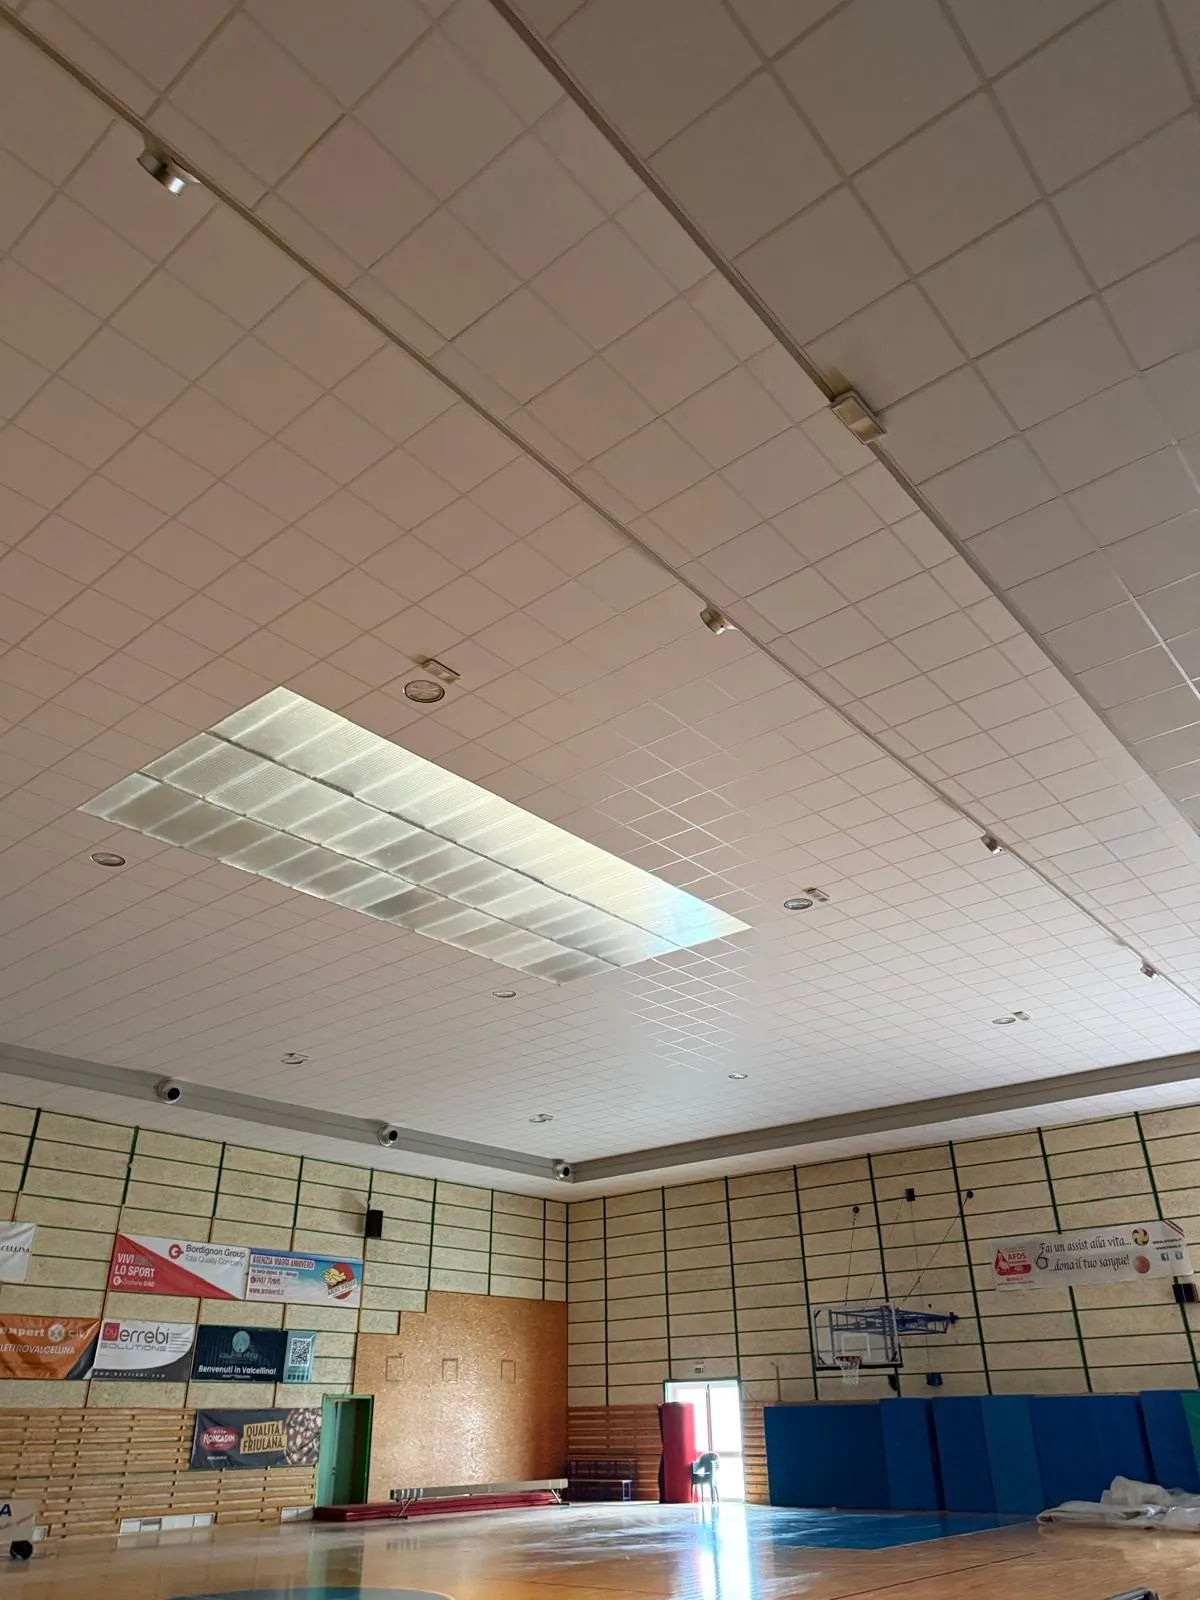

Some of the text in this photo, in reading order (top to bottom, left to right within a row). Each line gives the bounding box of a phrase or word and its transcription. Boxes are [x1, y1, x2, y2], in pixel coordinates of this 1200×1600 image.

[1054, 1243, 1065, 1252] un
[1067, 1239, 1088, 1251] assist
[1090, 1235, 1106, 1249] alla
[185, 1244, 246, 1259] Bordignon Group
[1007, 1252, 1027, 1261] AFDS
[117, 1253, 135, 1264] VIVI
[1075, 1257, 1082, 1269] il
[1083, 1260, 1097, 1269] tuo
[1099, 1254, 1130, 1271] sangue!
[115, 1265, 155, 1278] LO SPORT
[119, 1326, 170, 1344] errebi
[100, 1342, 167, 1352] SOLUTIONS
[198, 1365, 277, 1375] Benvenuti in Valcellina!
